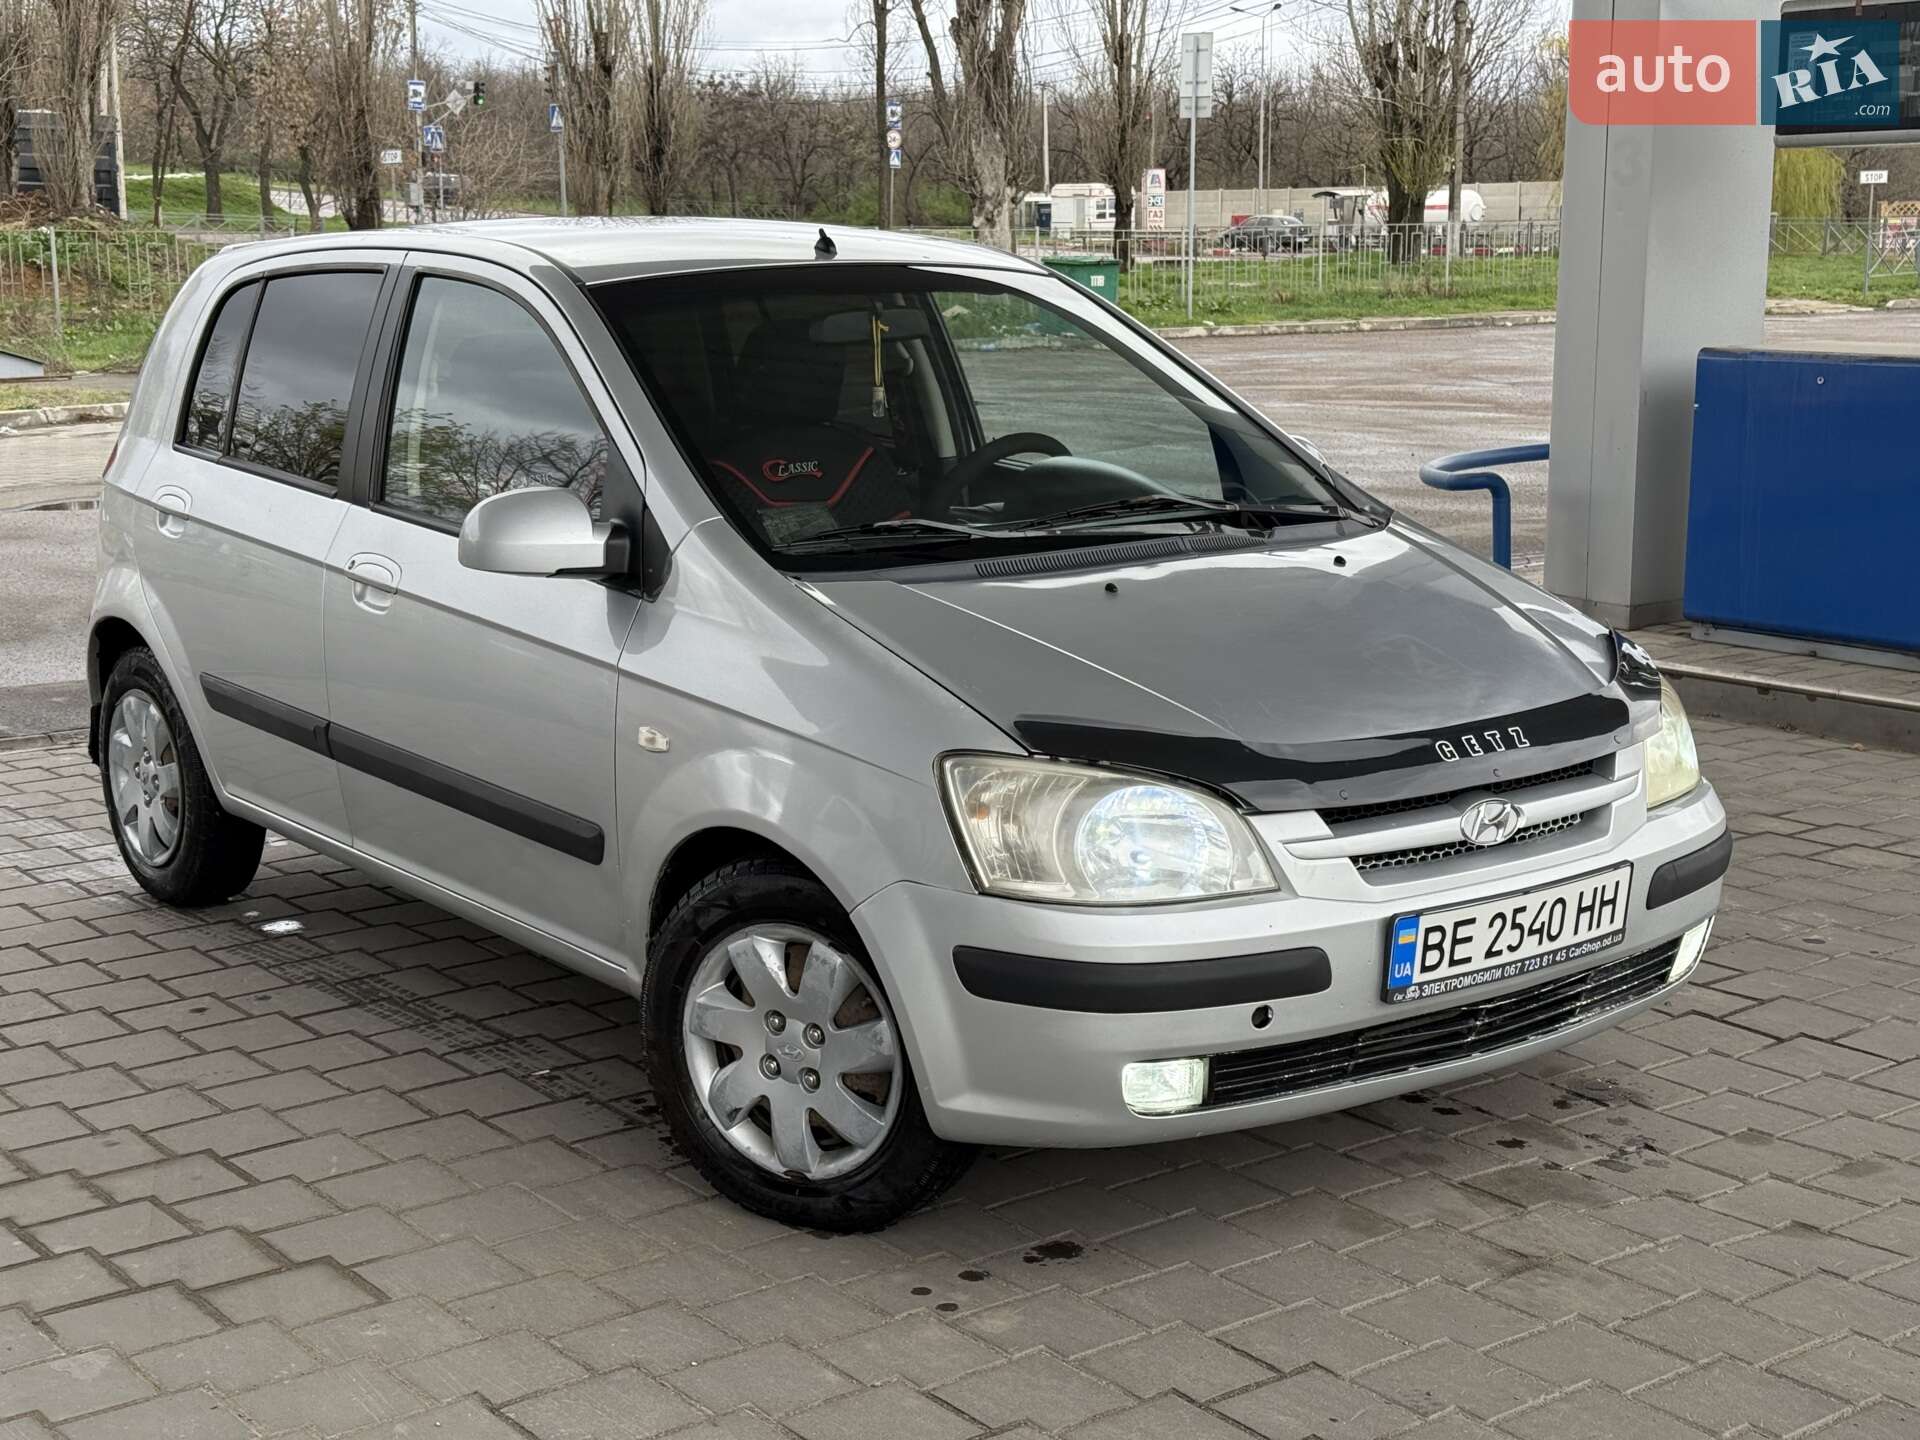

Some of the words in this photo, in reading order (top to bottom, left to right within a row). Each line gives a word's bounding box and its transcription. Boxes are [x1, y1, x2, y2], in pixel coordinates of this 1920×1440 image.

[1865, 173, 1884, 182] STOP
[1148, 210, 1163, 219] ГАЗ
[1435, 726, 1530, 762] GETZ
[1420, 917, 1477, 974] BE
[1484, 897, 1567, 960] 2540
[1573, 880, 1620, 936] HH
[1394, 961, 1412, 978] UA
[1421, 967, 1502, 996] ЭЛЕКТРОМОБИЛИ
[1504, 962, 1521, 977] 067
[1524, 958, 1540, 971] 723
[1555, 949, 1567, 961] 45
